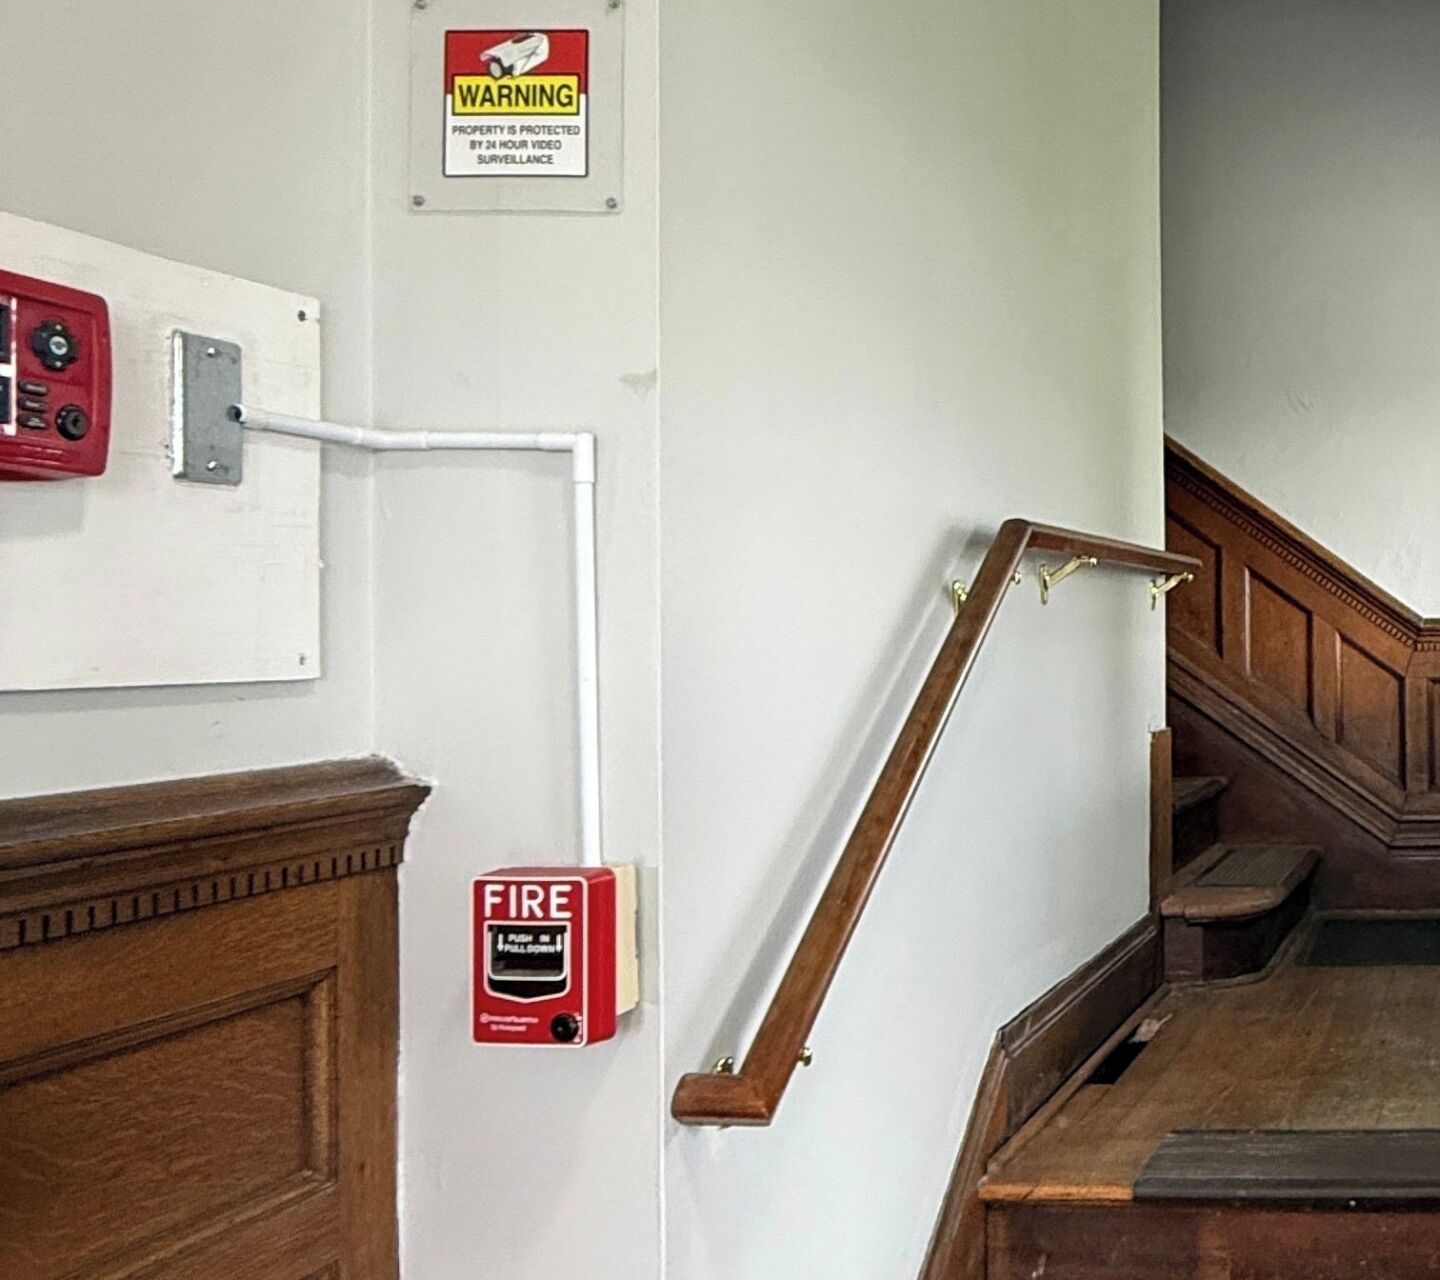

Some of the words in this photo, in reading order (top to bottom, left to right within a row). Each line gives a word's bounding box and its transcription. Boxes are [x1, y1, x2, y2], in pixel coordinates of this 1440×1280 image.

[458, 84, 574, 107] WARNING
[452, 125, 505, 135] PROPERTY
[507, 125, 517, 135] IS
[519, 125, 580, 135] PROTECTED
[469, 140, 483, 150] BY
[485, 140, 496, 150] 24
[499, 140, 528, 150] HOUR
[531, 140, 562, 150] VIDEO
[477, 154, 554, 165] SURVEILLANCE
[484, 884, 573, 918] FIRE
[507, 933, 533, 943] PUSH
